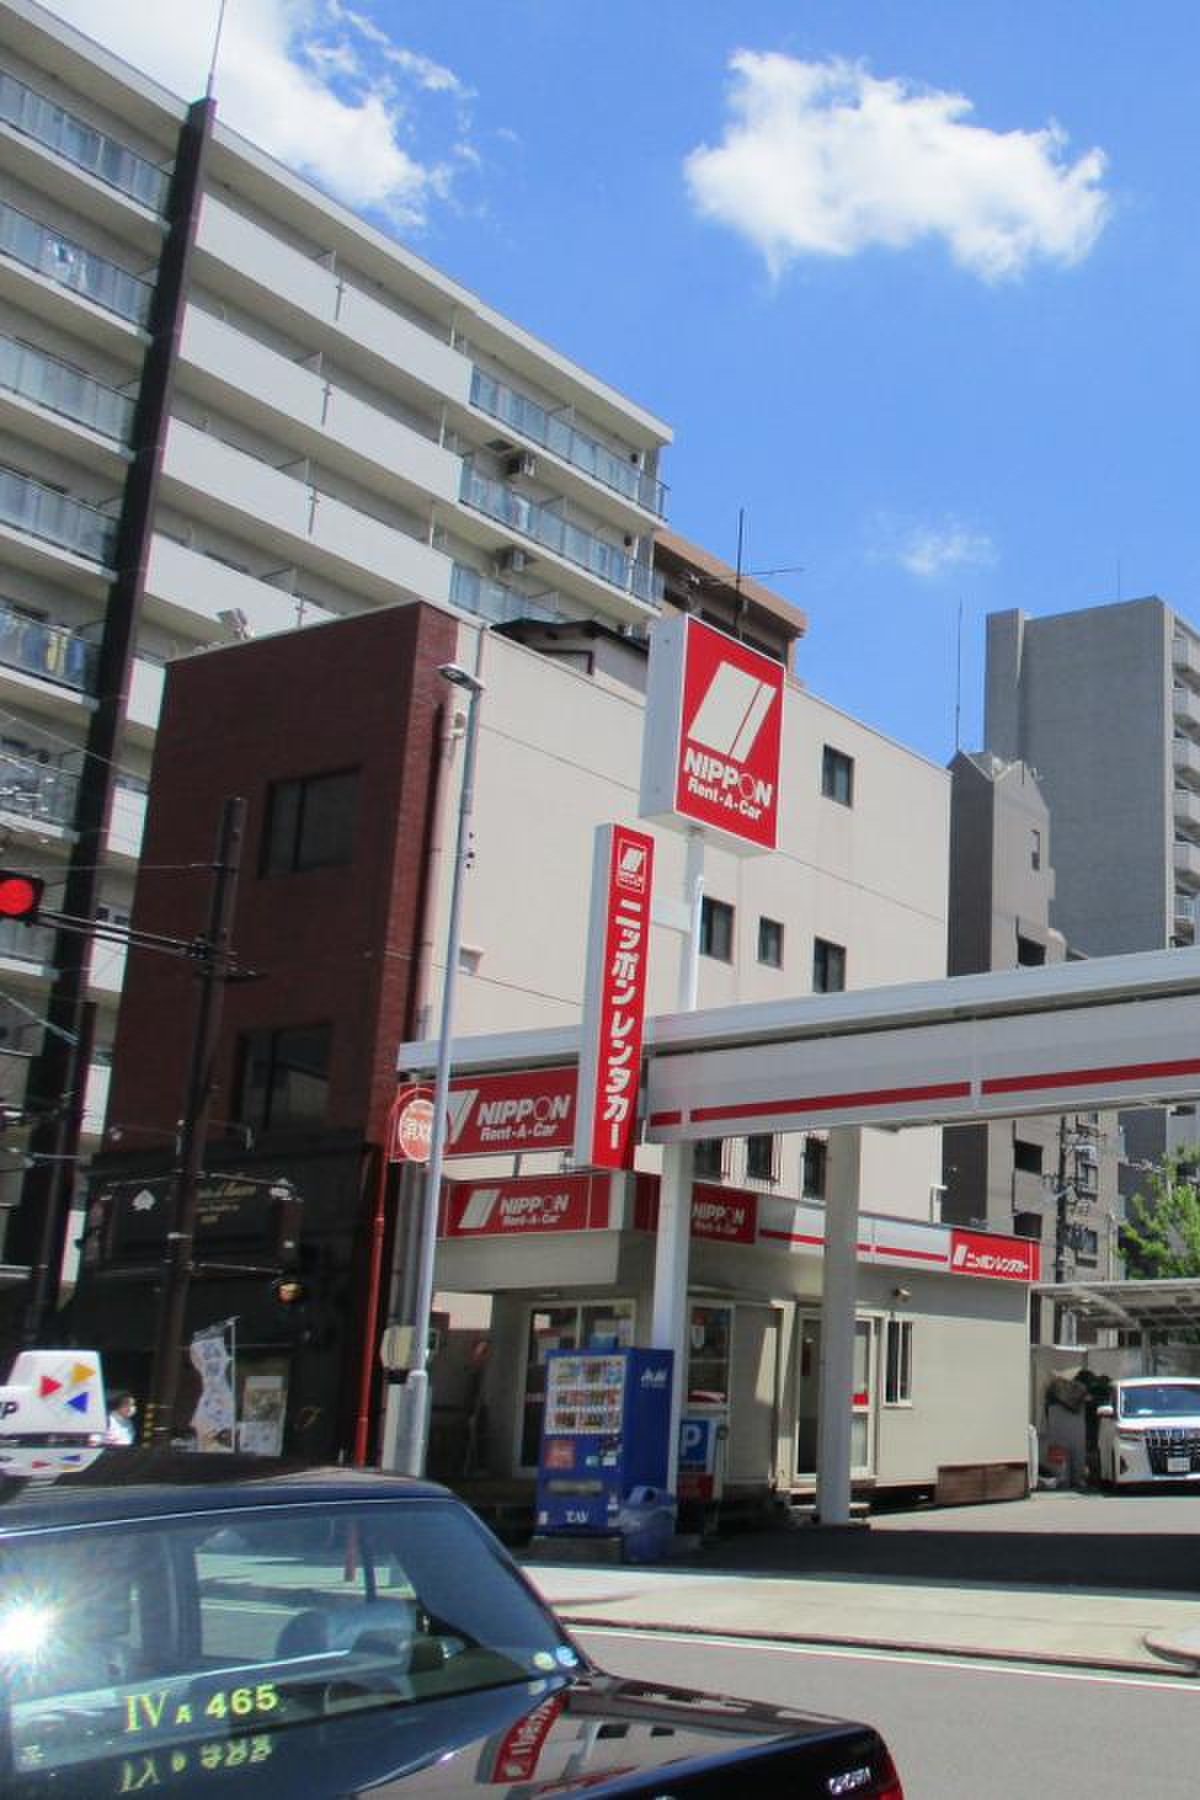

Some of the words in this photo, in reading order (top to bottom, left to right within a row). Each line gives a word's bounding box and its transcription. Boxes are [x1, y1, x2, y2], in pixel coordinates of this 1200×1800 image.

[684, 747, 772, 807] NIPPON
[687, 777, 763, 821] Rent-A-Car
[603, 899, 642, 1149] ニッポンレンタカー
[477, 1094, 571, 1127] NIPPON
[500, 1194, 569, 1216] NIPPON
[681, 1423, 702, 1456] P
[125, 1690, 170, 1732] IV
[205, 1683, 279, 1718] 465
